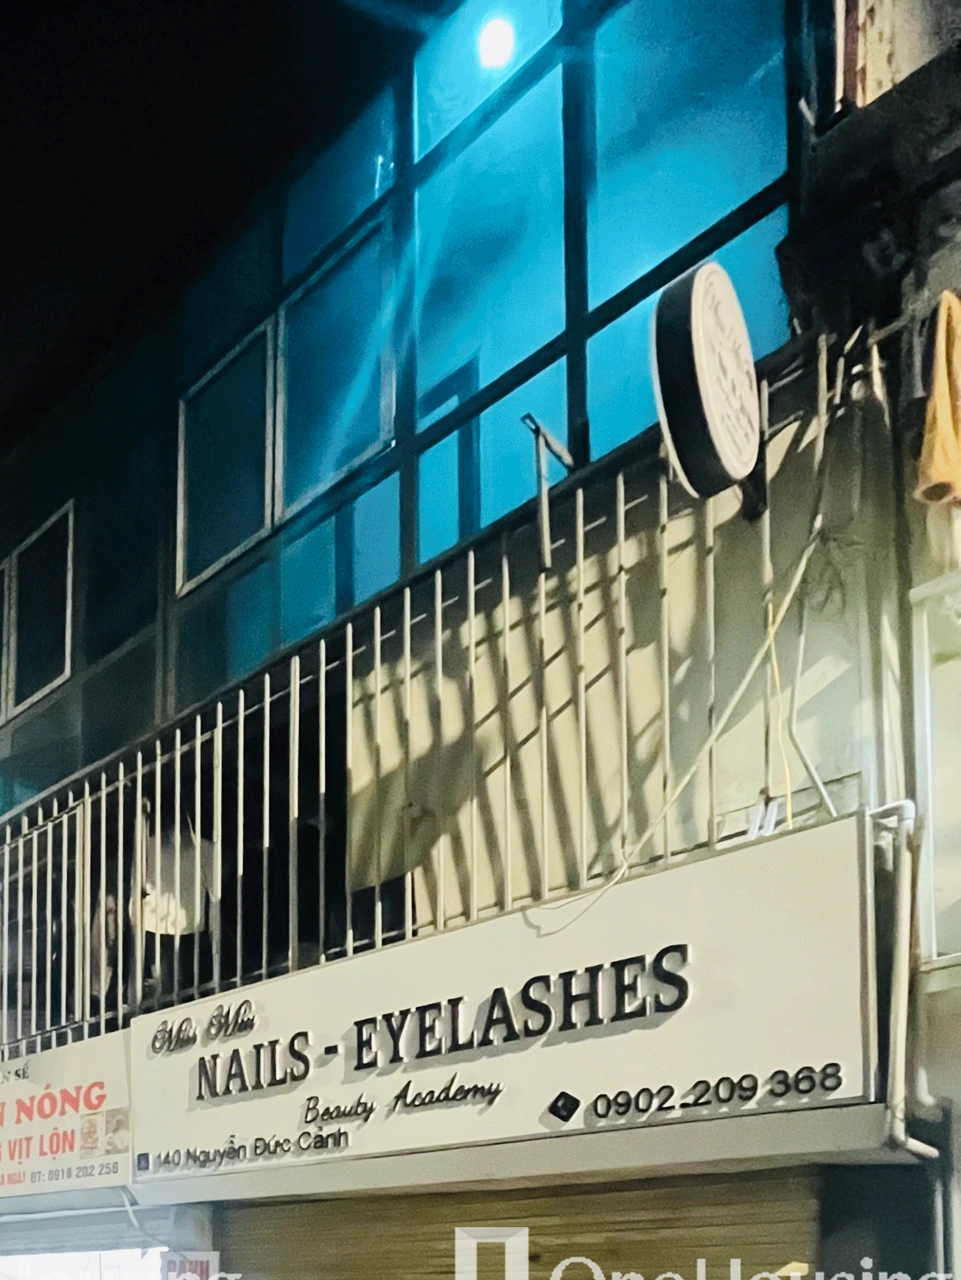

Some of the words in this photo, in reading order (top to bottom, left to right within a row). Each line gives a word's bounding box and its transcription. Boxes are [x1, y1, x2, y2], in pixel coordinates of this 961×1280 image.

[196, 1030, 312, 1100] NAILS
[353, 943, 691, 1071] EYELASHES
[15, 1080, 108, 1125] NÓNG
[304, 1092, 378, 1124] Beauty
[392, 1071, 505, 1109] Academy
[7, 1136, 34, 1165] VỊT
[38, 1126, 75, 1160] LỘN
[156, 1149, 182, 1167] 140
[186, 1134, 247, 1168] Nguyễn
[254, 1134, 291, 1156] Đức
[297, 1126, 350, 1150] Cảnh
[48, 1166, 72, 1181] 0918
[76, 1164, 95, 1178] 202
[98, 1161, 119, 1176] 258
